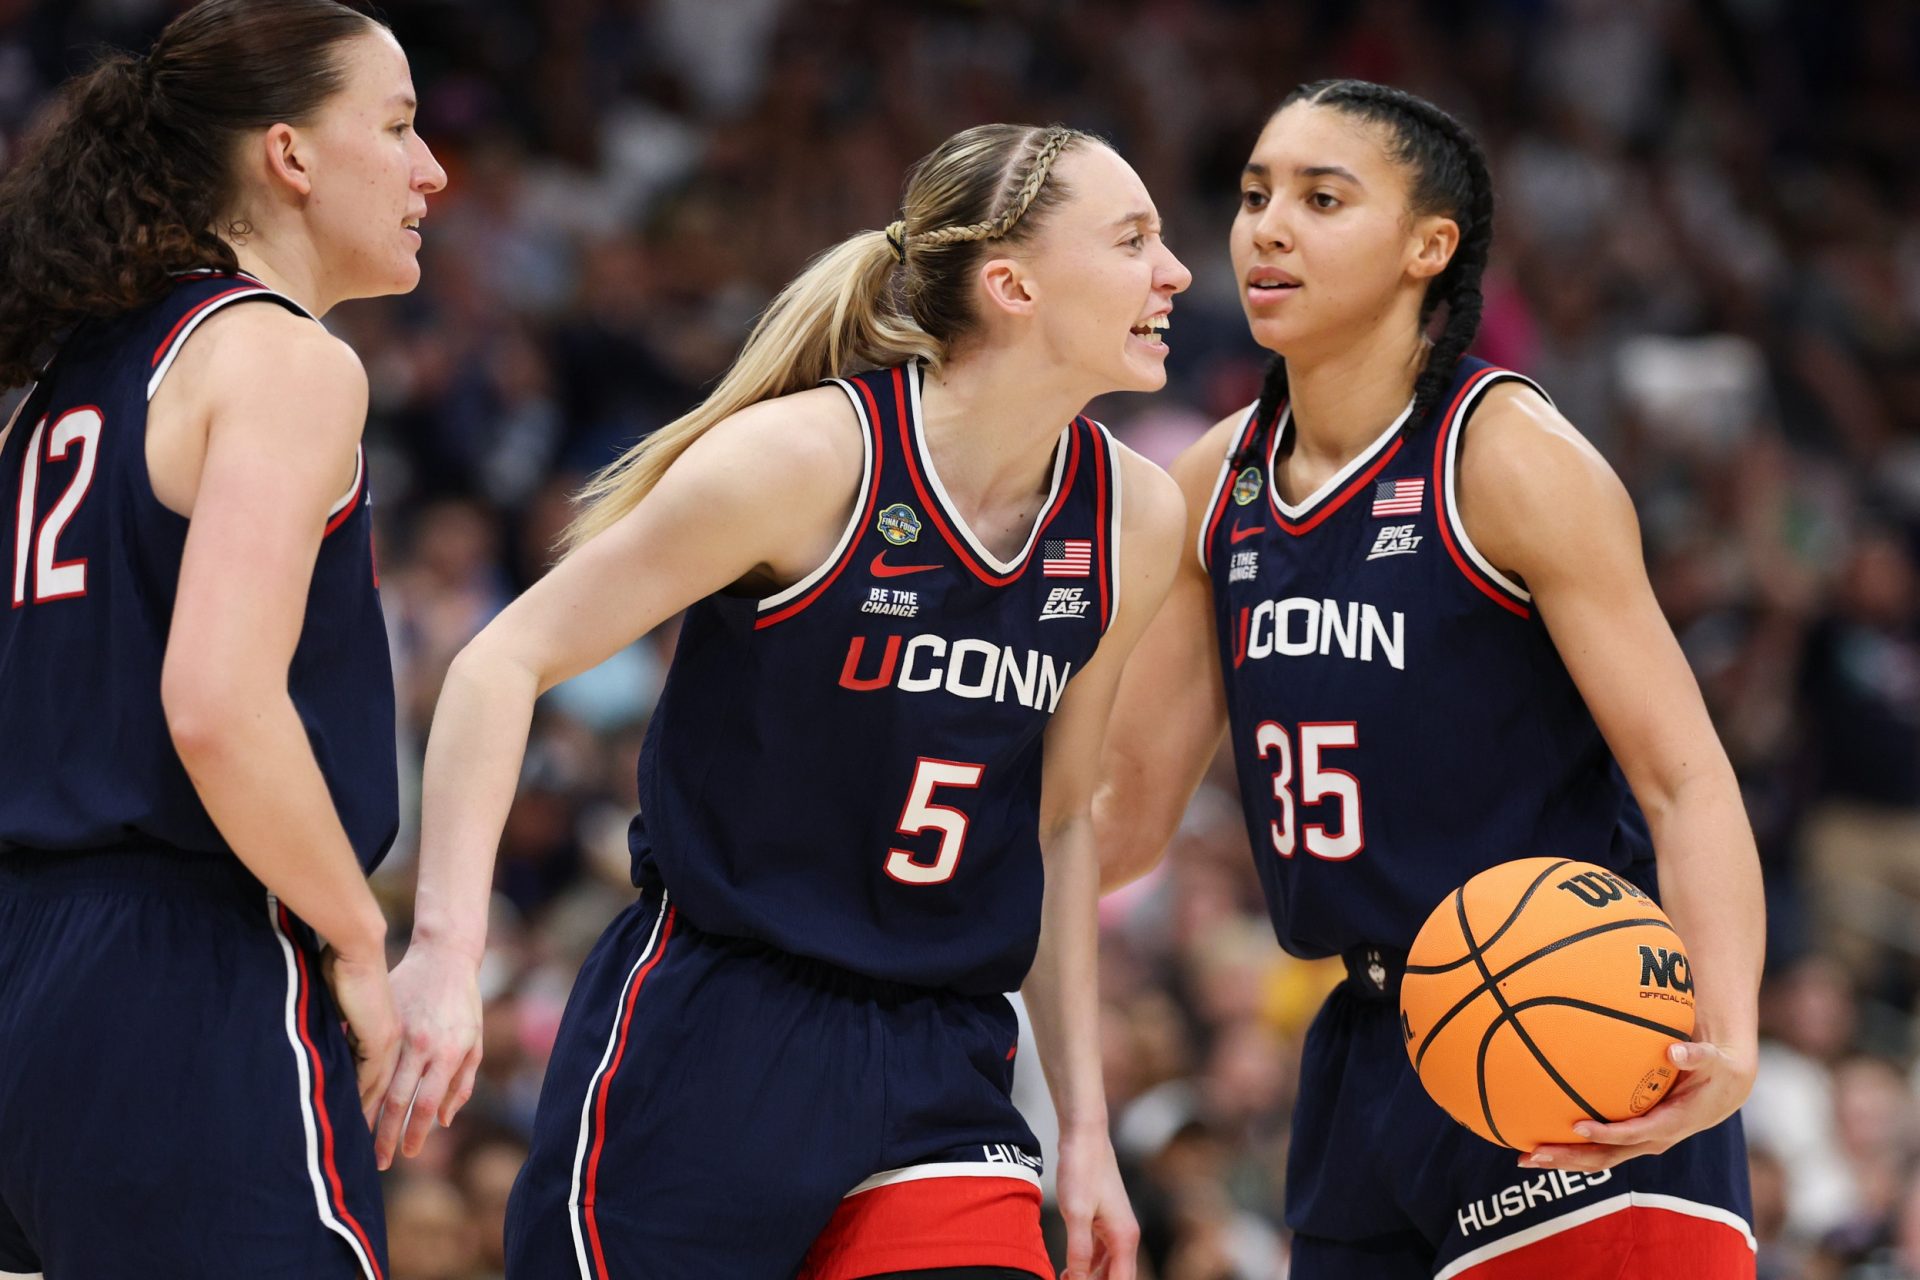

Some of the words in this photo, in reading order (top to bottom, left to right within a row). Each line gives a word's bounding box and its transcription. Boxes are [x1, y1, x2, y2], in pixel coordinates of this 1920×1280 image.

[11, 403, 105, 610] 12
[881, 516, 899, 528] FINAL
[900, 520, 917, 535] FOUR
[1377, 524, 1416, 539] BIG
[1371, 536, 1423, 553] EAST
[1236, 551, 1259, 567] THE
[869, 587, 890, 602] BE
[892, 590, 918, 605] THE
[1047, 587, 1084, 601] BIG
[861, 601, 919, 618] CHANGE
[1041, 600, 1091, 615] EAST
[838, 633, 1071, 714] UCONN
[1255, 719, 1365, 861] 35
[883, 756, 986, 886] 5
[1638, 944, 1695, 999] NCA
[1639, 991, 1680, 1003] OFFICIAL
